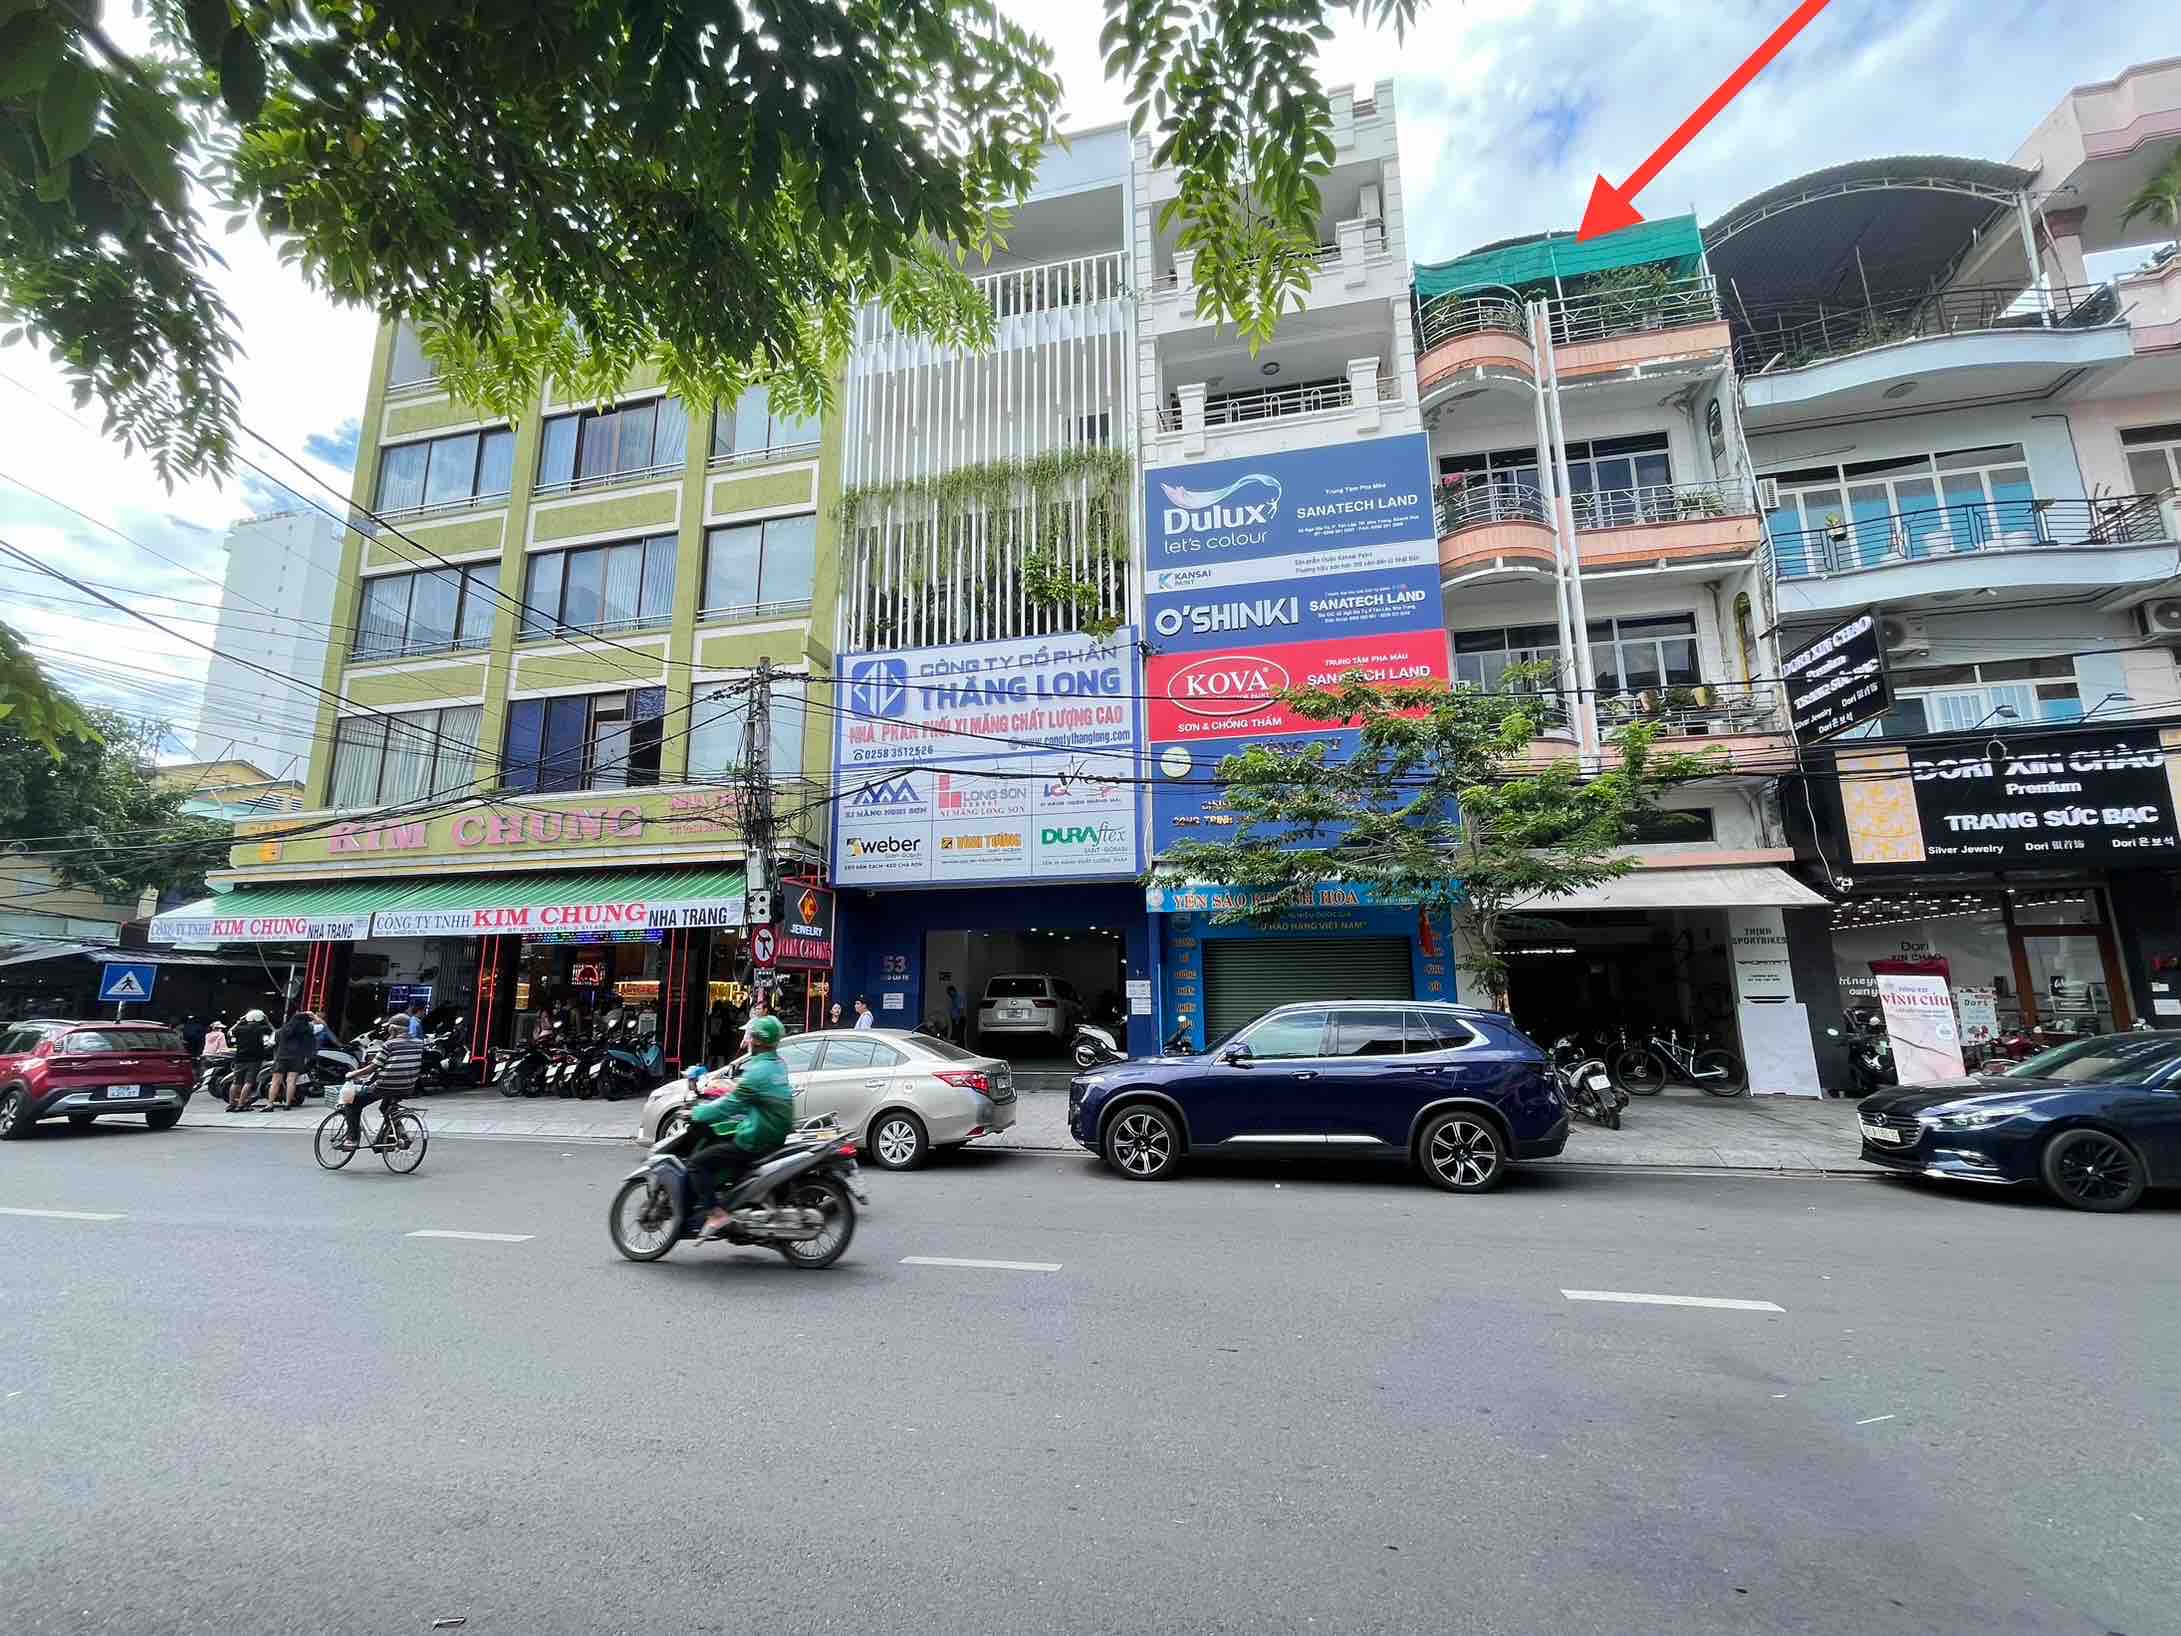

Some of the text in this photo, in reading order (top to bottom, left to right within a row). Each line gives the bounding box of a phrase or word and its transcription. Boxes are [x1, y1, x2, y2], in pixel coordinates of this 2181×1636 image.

[1296, 494, 1418, 519] SANATECH LAND
[1163, 504, 1267, 535] Dulux
[1164, 532, 1268, 554] let's colour
[1174, 569, 1212, 581] KANSAI
[1309, 593, 1384, 612] SANATECH
[1387, 590, 1426, 604] LAND
[1155, 597, 1298, 636] O'SHINKI
[921, 658, 980, 677] CÔNG
[985, 655, 1014, 671] TY
[1307, 665, 1430, 686] SANECH LAND
[919, 667, 1121, 711] THĂNG LONG
[1185, 669, 1270, 697] KOVA
[1793, 683, 1831, 710] TRANG
[1011, 707, 1044, 732] CHẤT
[1096, 705, 1123, 725] CAO
[1178, 722, 1200, 733] SƠN
[1202, 723, 1210, 731] &
[865, 748, 889, 760] 0258
[1912, 757, 1993, 781] DORI
[963, 788, 998, 801] LONG
[2005, 780, 2083, 796] Premium
[1943, 805, 2159, 832] TRANG SỨC BẠC
[328, 806, 643, 854] KIM CHUNG
[861, 836, 921, 854] weber
[1928, 843, 2004, 856] Silver Jewelry
[2024, 841, 2049, 851] Dori
[2112, 838, 2136, 848] Dori
[1174, 887, 1207, 910] YẾN
[1319, 886, 1360, 905] HÒA
[376, 912, 410, 930] CÔNG
[415, 915, 433, 930] TY
[433, 914, 472, 930] TNHH
[472, 905, 530, 929] KIM
[540, 903, 649, 925] CHUNG
[649, 909, 678, 927] NHA
[682, 906, 728, 925] TRANG
[211, 918, 245, 936] KIM
[250, 917, 307, 936] CHUNG
[306, 925, 324, 939] NHA
[327, 922, 354, 939] TRANG
[790, 923, 824, 937] JEWELRY
[799, 938, 832, 960] CHUNG
[884, 955, 906, 973] 53
